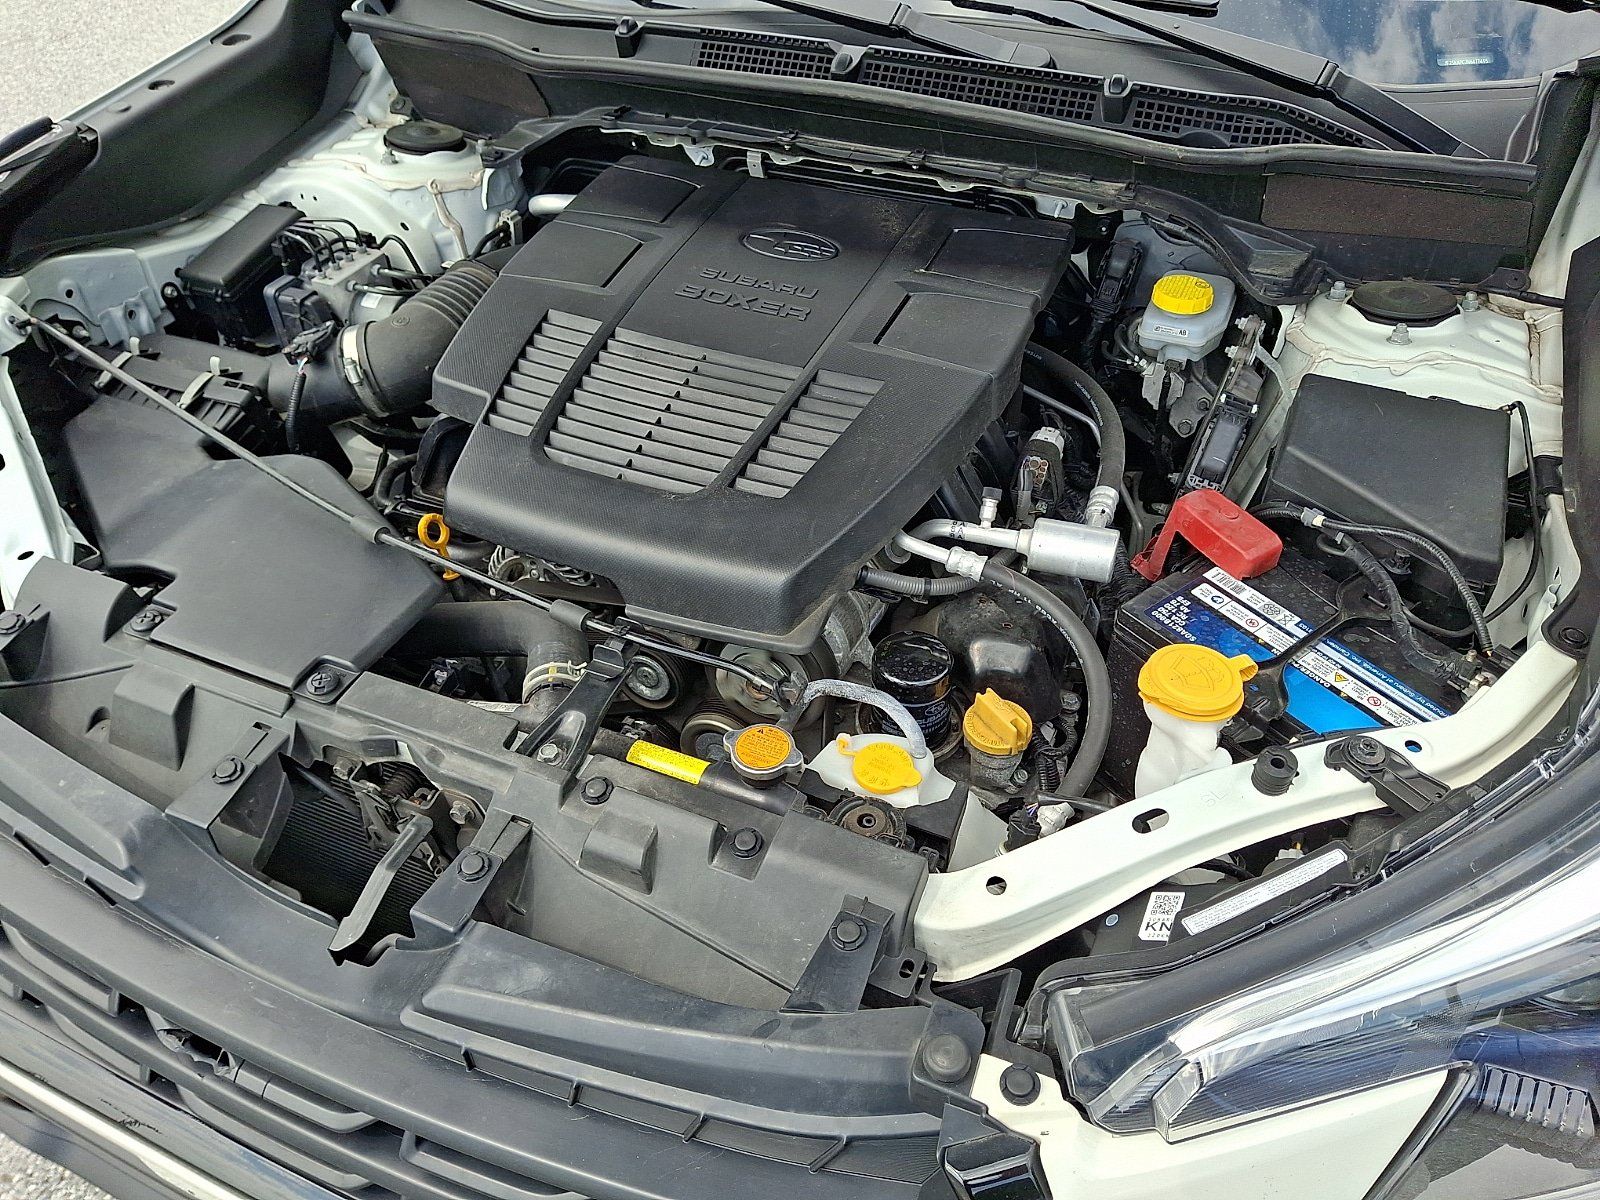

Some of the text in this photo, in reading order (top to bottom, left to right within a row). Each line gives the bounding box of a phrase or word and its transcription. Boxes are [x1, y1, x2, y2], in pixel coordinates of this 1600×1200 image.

[700, 268, 819, 299] SUBARU
[674, 283, 812, 322] BOXER
[1157, 606, 1186, 626] CCA 750
[1163, 602, 1188, 621] RC 120
